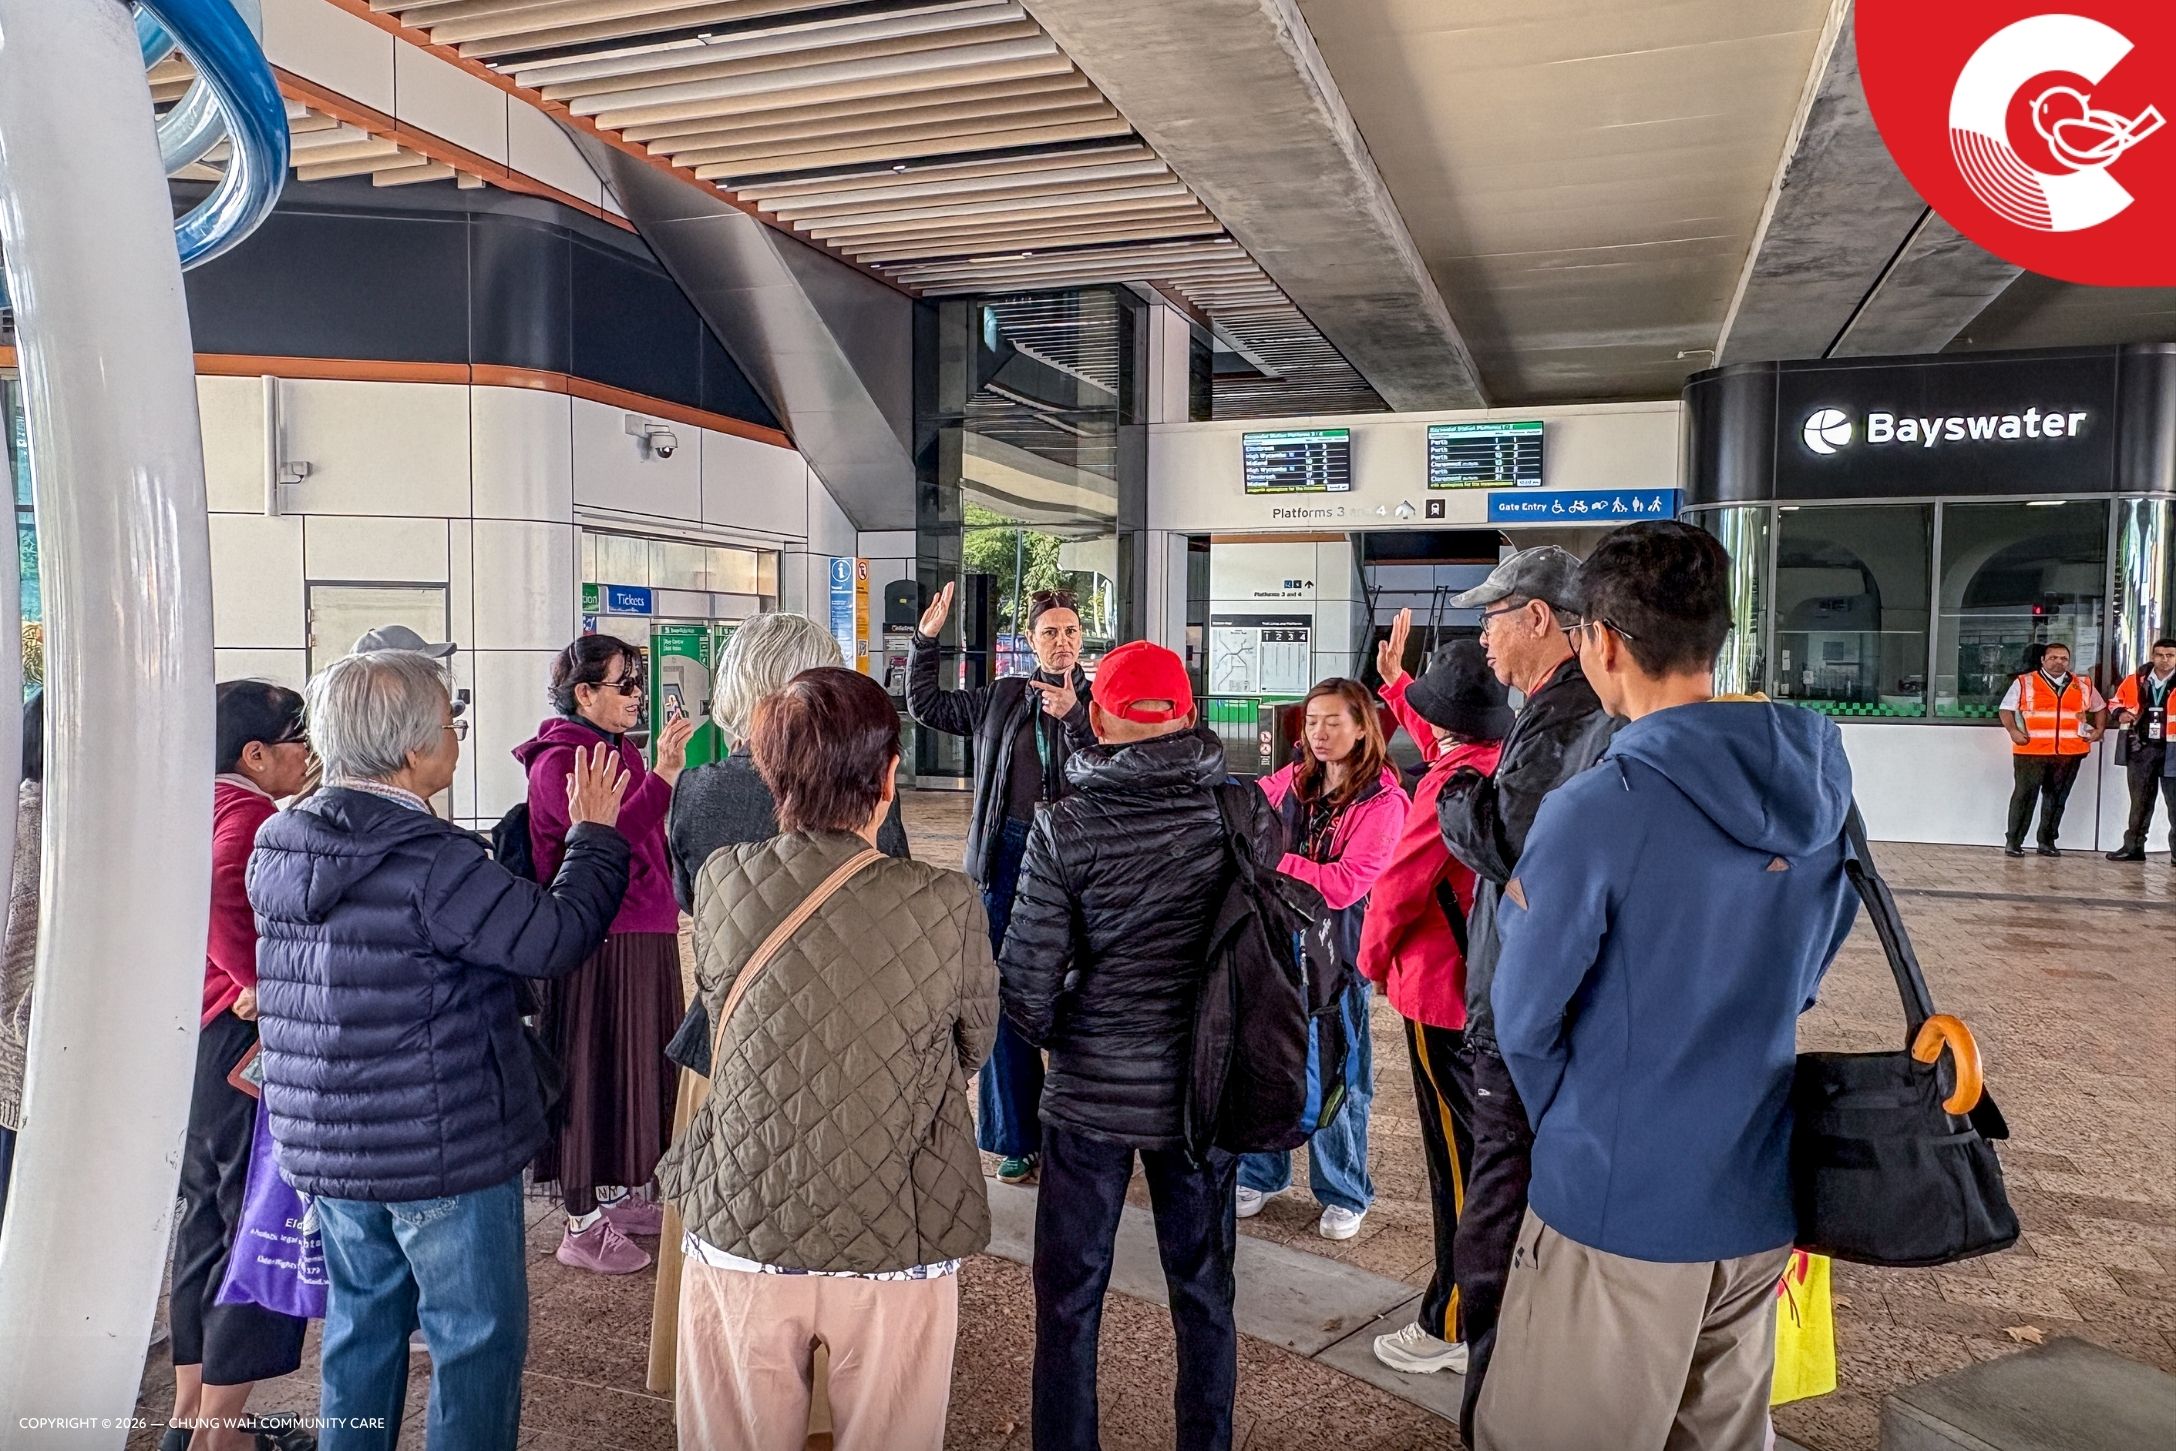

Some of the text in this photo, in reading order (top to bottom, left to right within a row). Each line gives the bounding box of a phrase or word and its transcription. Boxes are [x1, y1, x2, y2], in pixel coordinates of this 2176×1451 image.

[1867, 407, 2087, 447] Bayswater
[1431, 439, 1448, 447] Perth
[1431, 446, 1448, 454] Perth
[1431, 454, 1448, 462] Perth
[1431, 468, 1448, 476] Perth
[1273, 506, 1333, 519] Platforms
[1337, 506, 1345, 517] 3
[1375, 505, 1386, 516] 4
[1498, 503, 1547, 513] Gate Entry
[616, 592, 645, 607] Tickets
[1265, 633, 1269, 641] 1
[1276, 633, 1282, 641] 2
[1287, 633, 1294, 641] 3
[1300, 633, 1306, 641] 4
